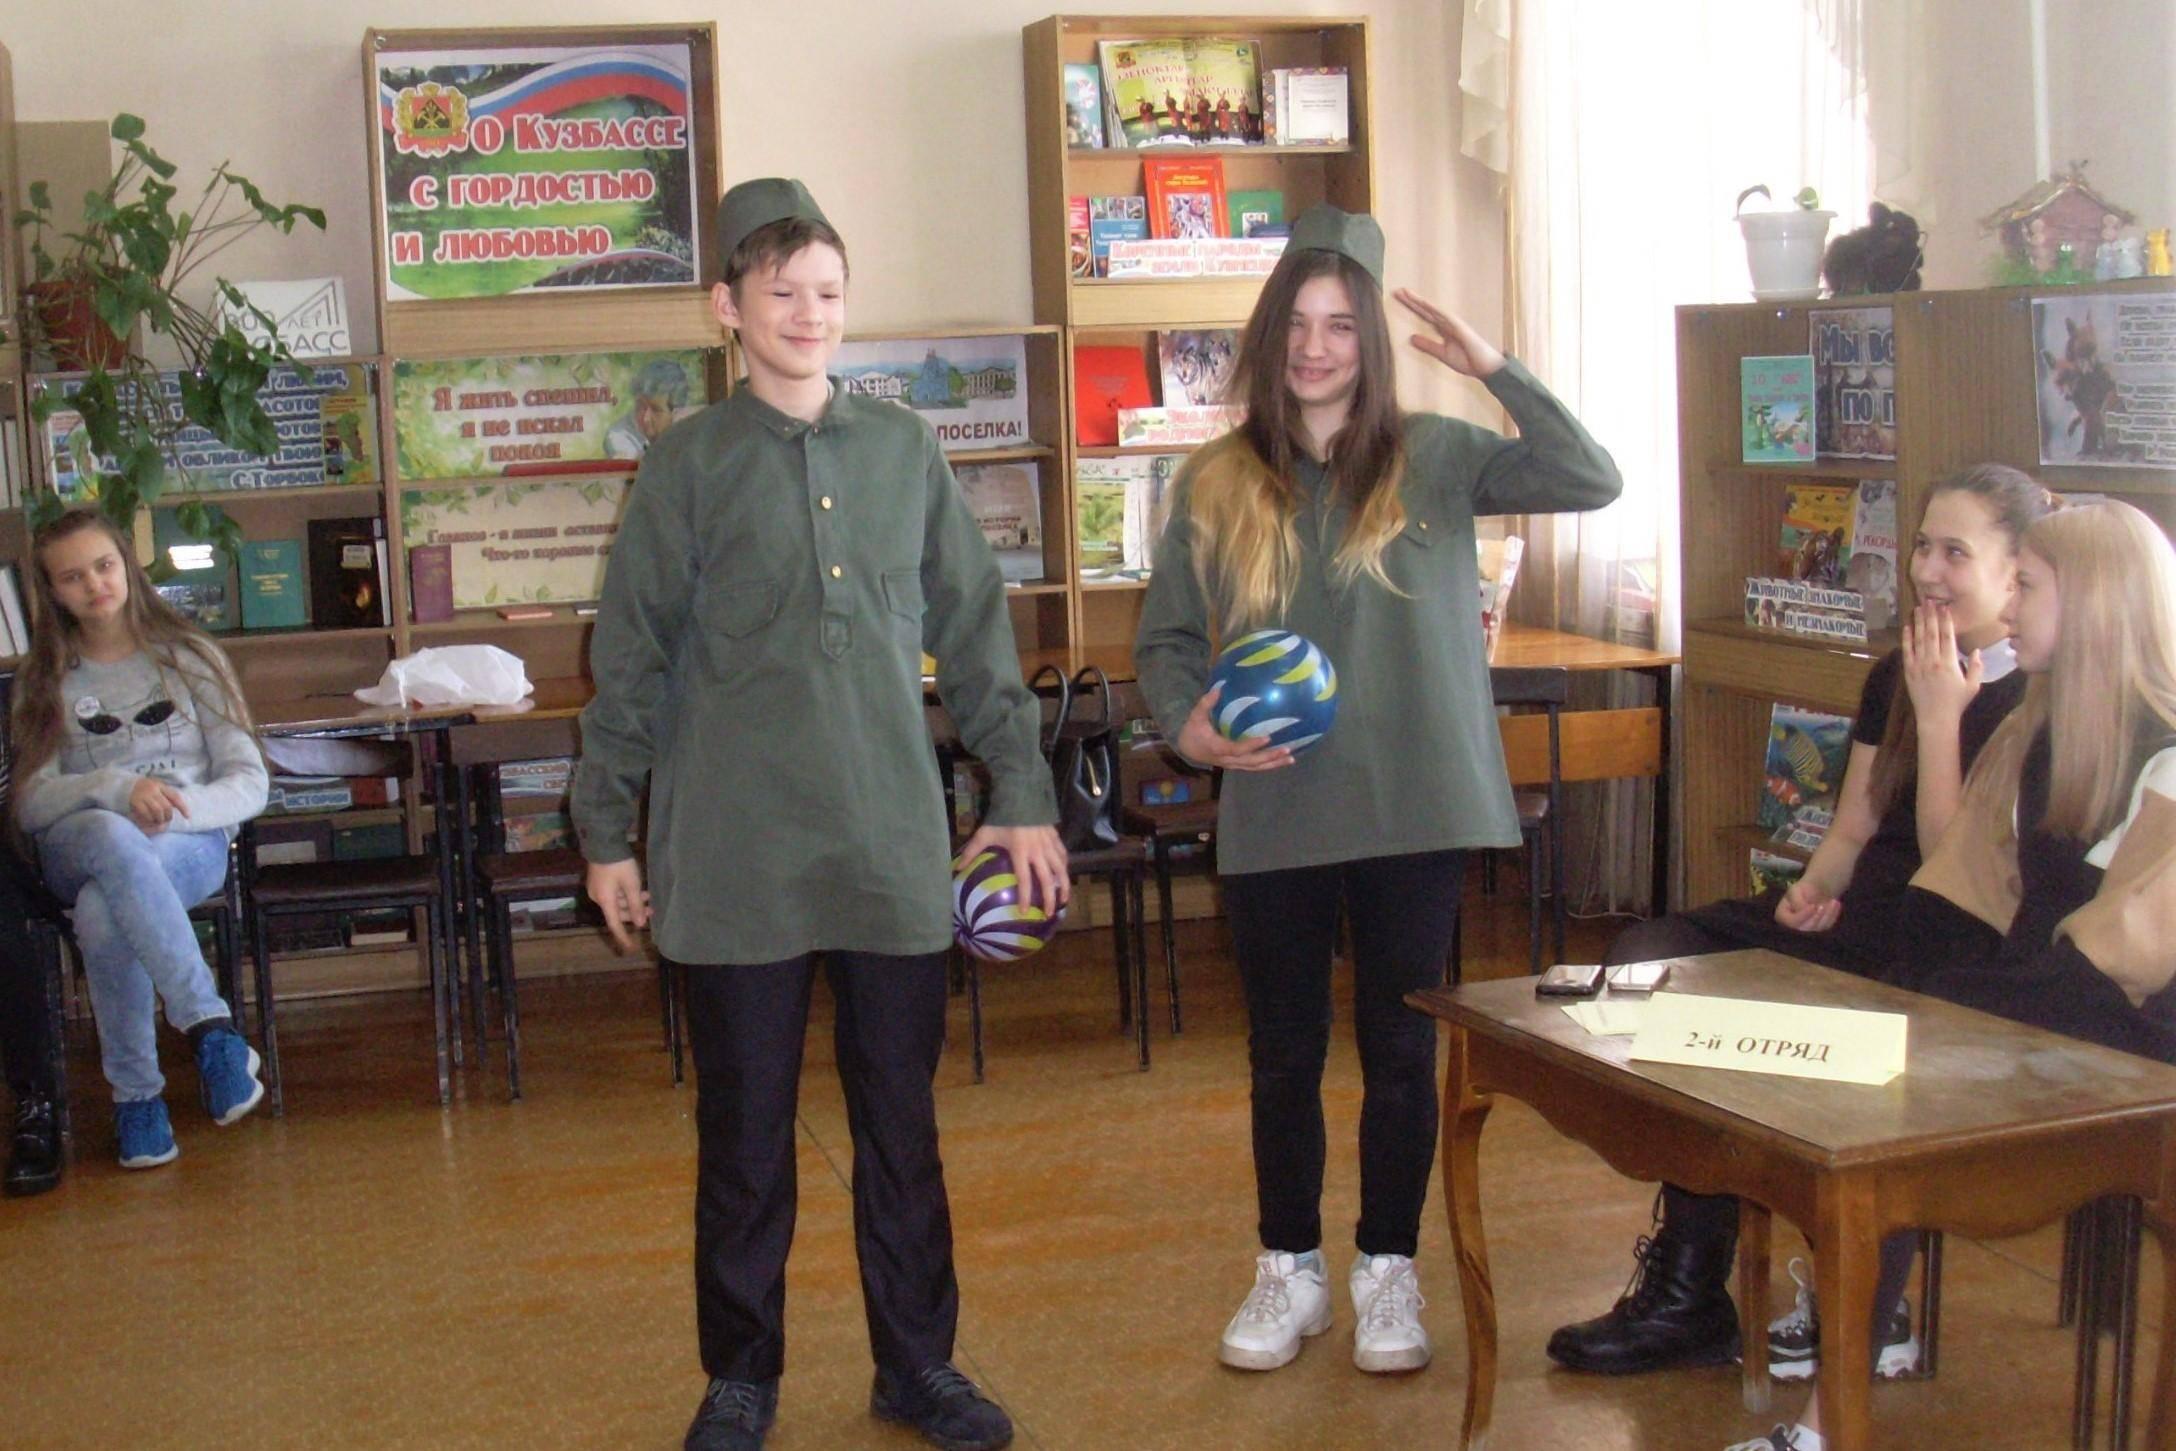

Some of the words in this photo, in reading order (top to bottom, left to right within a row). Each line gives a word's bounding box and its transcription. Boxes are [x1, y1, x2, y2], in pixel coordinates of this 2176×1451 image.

[472, 116, 503, 152] О
[411, 177, 438, 208] С
[449, 170, 655, 207] ГОРДОСТЬЮ
[394, 232, 422, 263] И
[434, 226, 611, 260] ЛЮБОВЬЮ
[434, 387, 452, 411] Я
[937, 420, 1022, 440] ПОСЕЛКА!
[1685, 1031, 1723, 1050] 2-й
[1736, 1036, 1831, 1062] ОТРЯД
